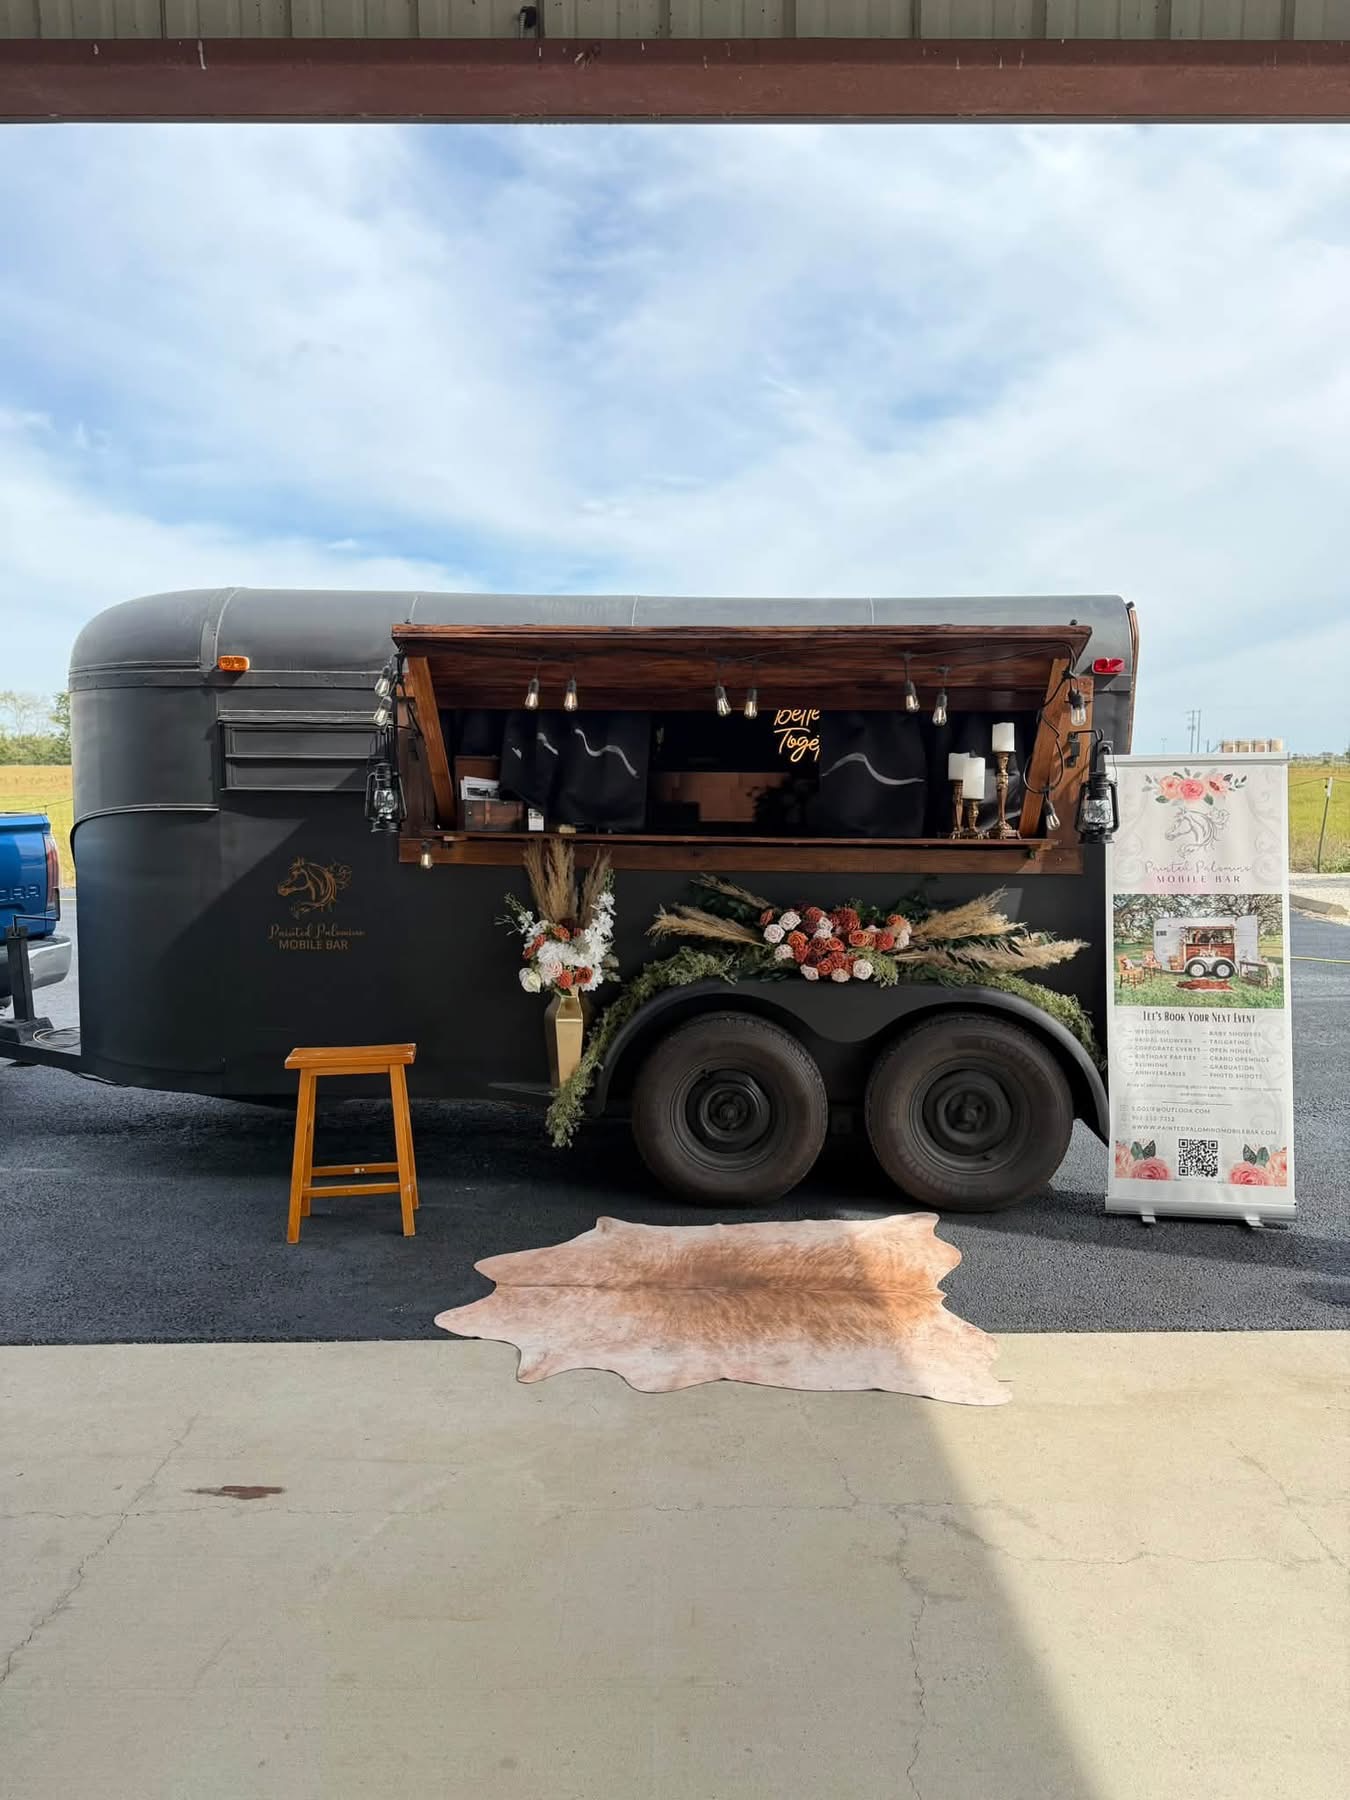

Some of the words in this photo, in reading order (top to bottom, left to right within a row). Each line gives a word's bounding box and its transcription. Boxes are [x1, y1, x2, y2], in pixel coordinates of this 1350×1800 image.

[1157, 875, 1207, 884] MOBILE
[1215, 875, 1241, 884] BAR
[279, 940, 322, 950] MOBILE
[325, 940, 349, 950] BAR
